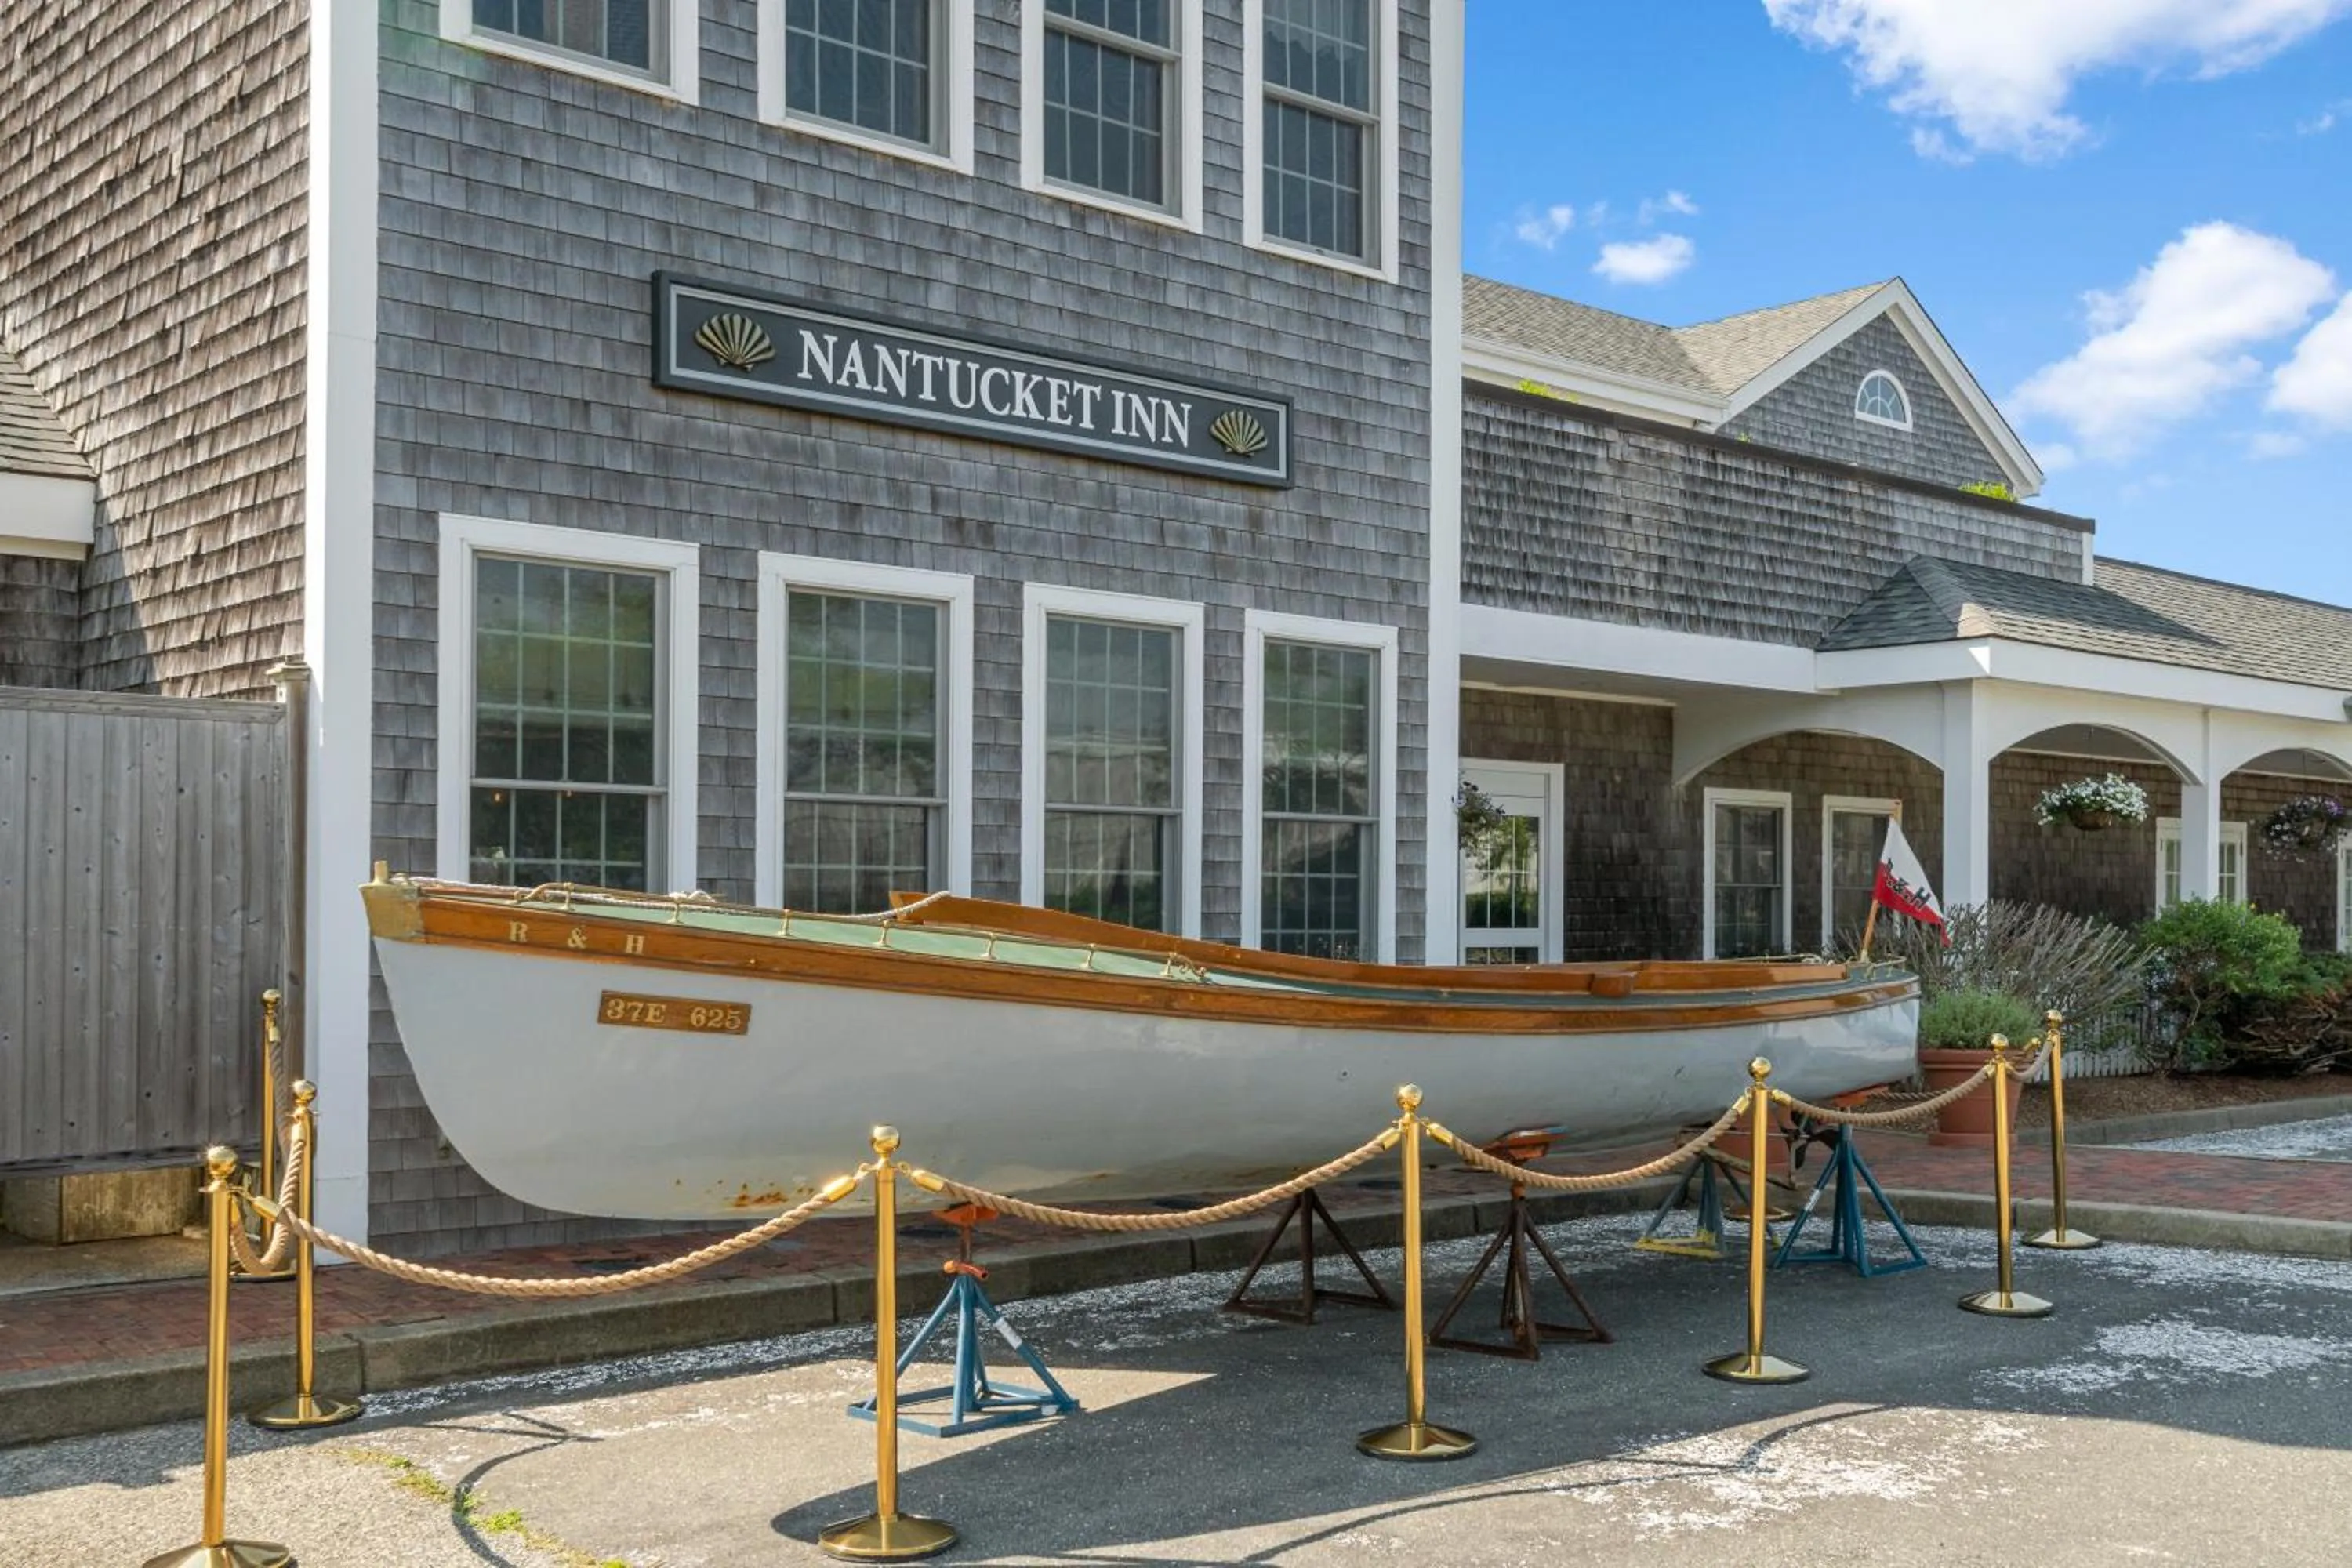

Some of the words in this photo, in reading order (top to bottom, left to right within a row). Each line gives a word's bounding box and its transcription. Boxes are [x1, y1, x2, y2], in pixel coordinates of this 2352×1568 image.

[797, 329, 1102, 430] NANTUCKET
[1111, 390, 1192, 448] INN
[567, 924, 587, 949] &
[626, 934, 645, 955] H
[606, 998, 666, 1023] 37E
[690, 1007, 742, 1029] 625
